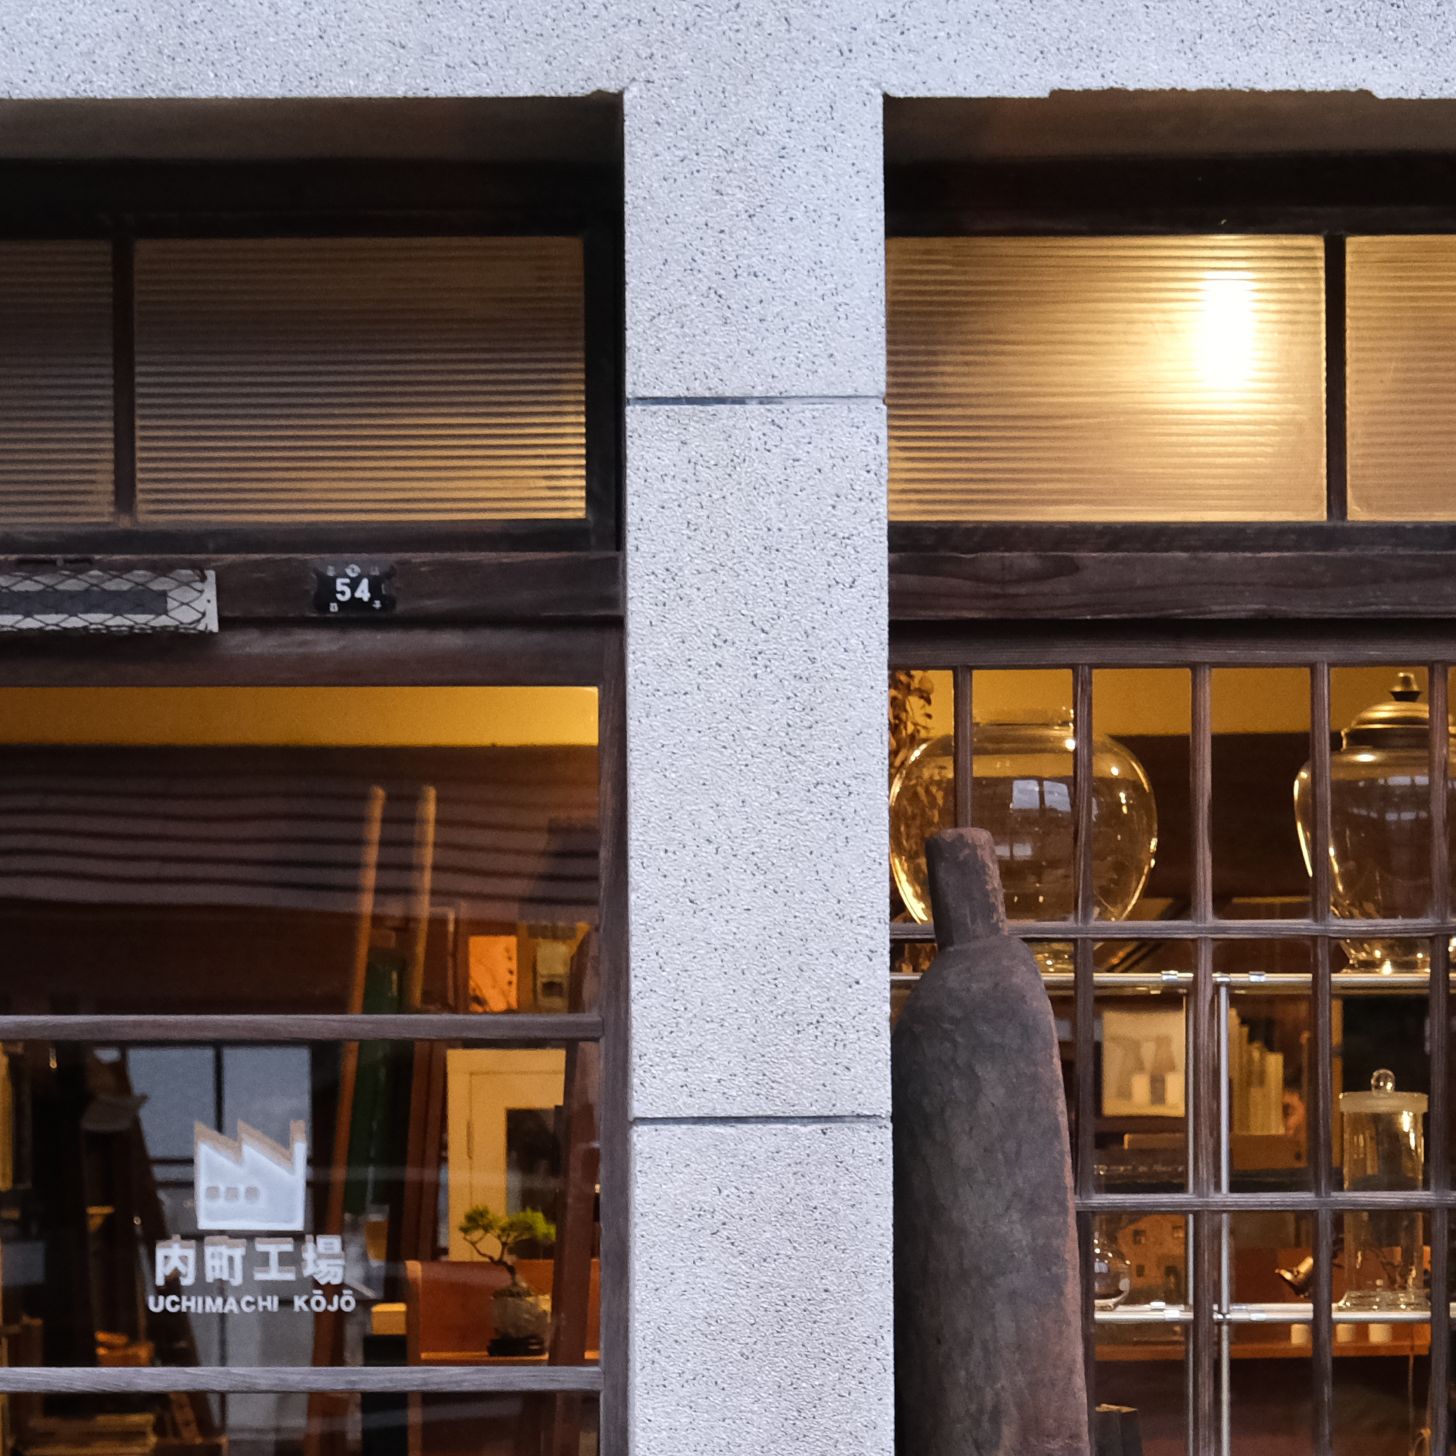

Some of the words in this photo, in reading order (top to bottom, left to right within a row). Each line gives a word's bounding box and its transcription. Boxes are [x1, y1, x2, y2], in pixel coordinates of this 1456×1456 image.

[335, 577, 371, 602] 54
[155, 1234, 344, 1287] 内町工場
[148, 1294, 279, 1314] UCHIMACHI
[293, 1289, 356, 1313] KŌJŌ
